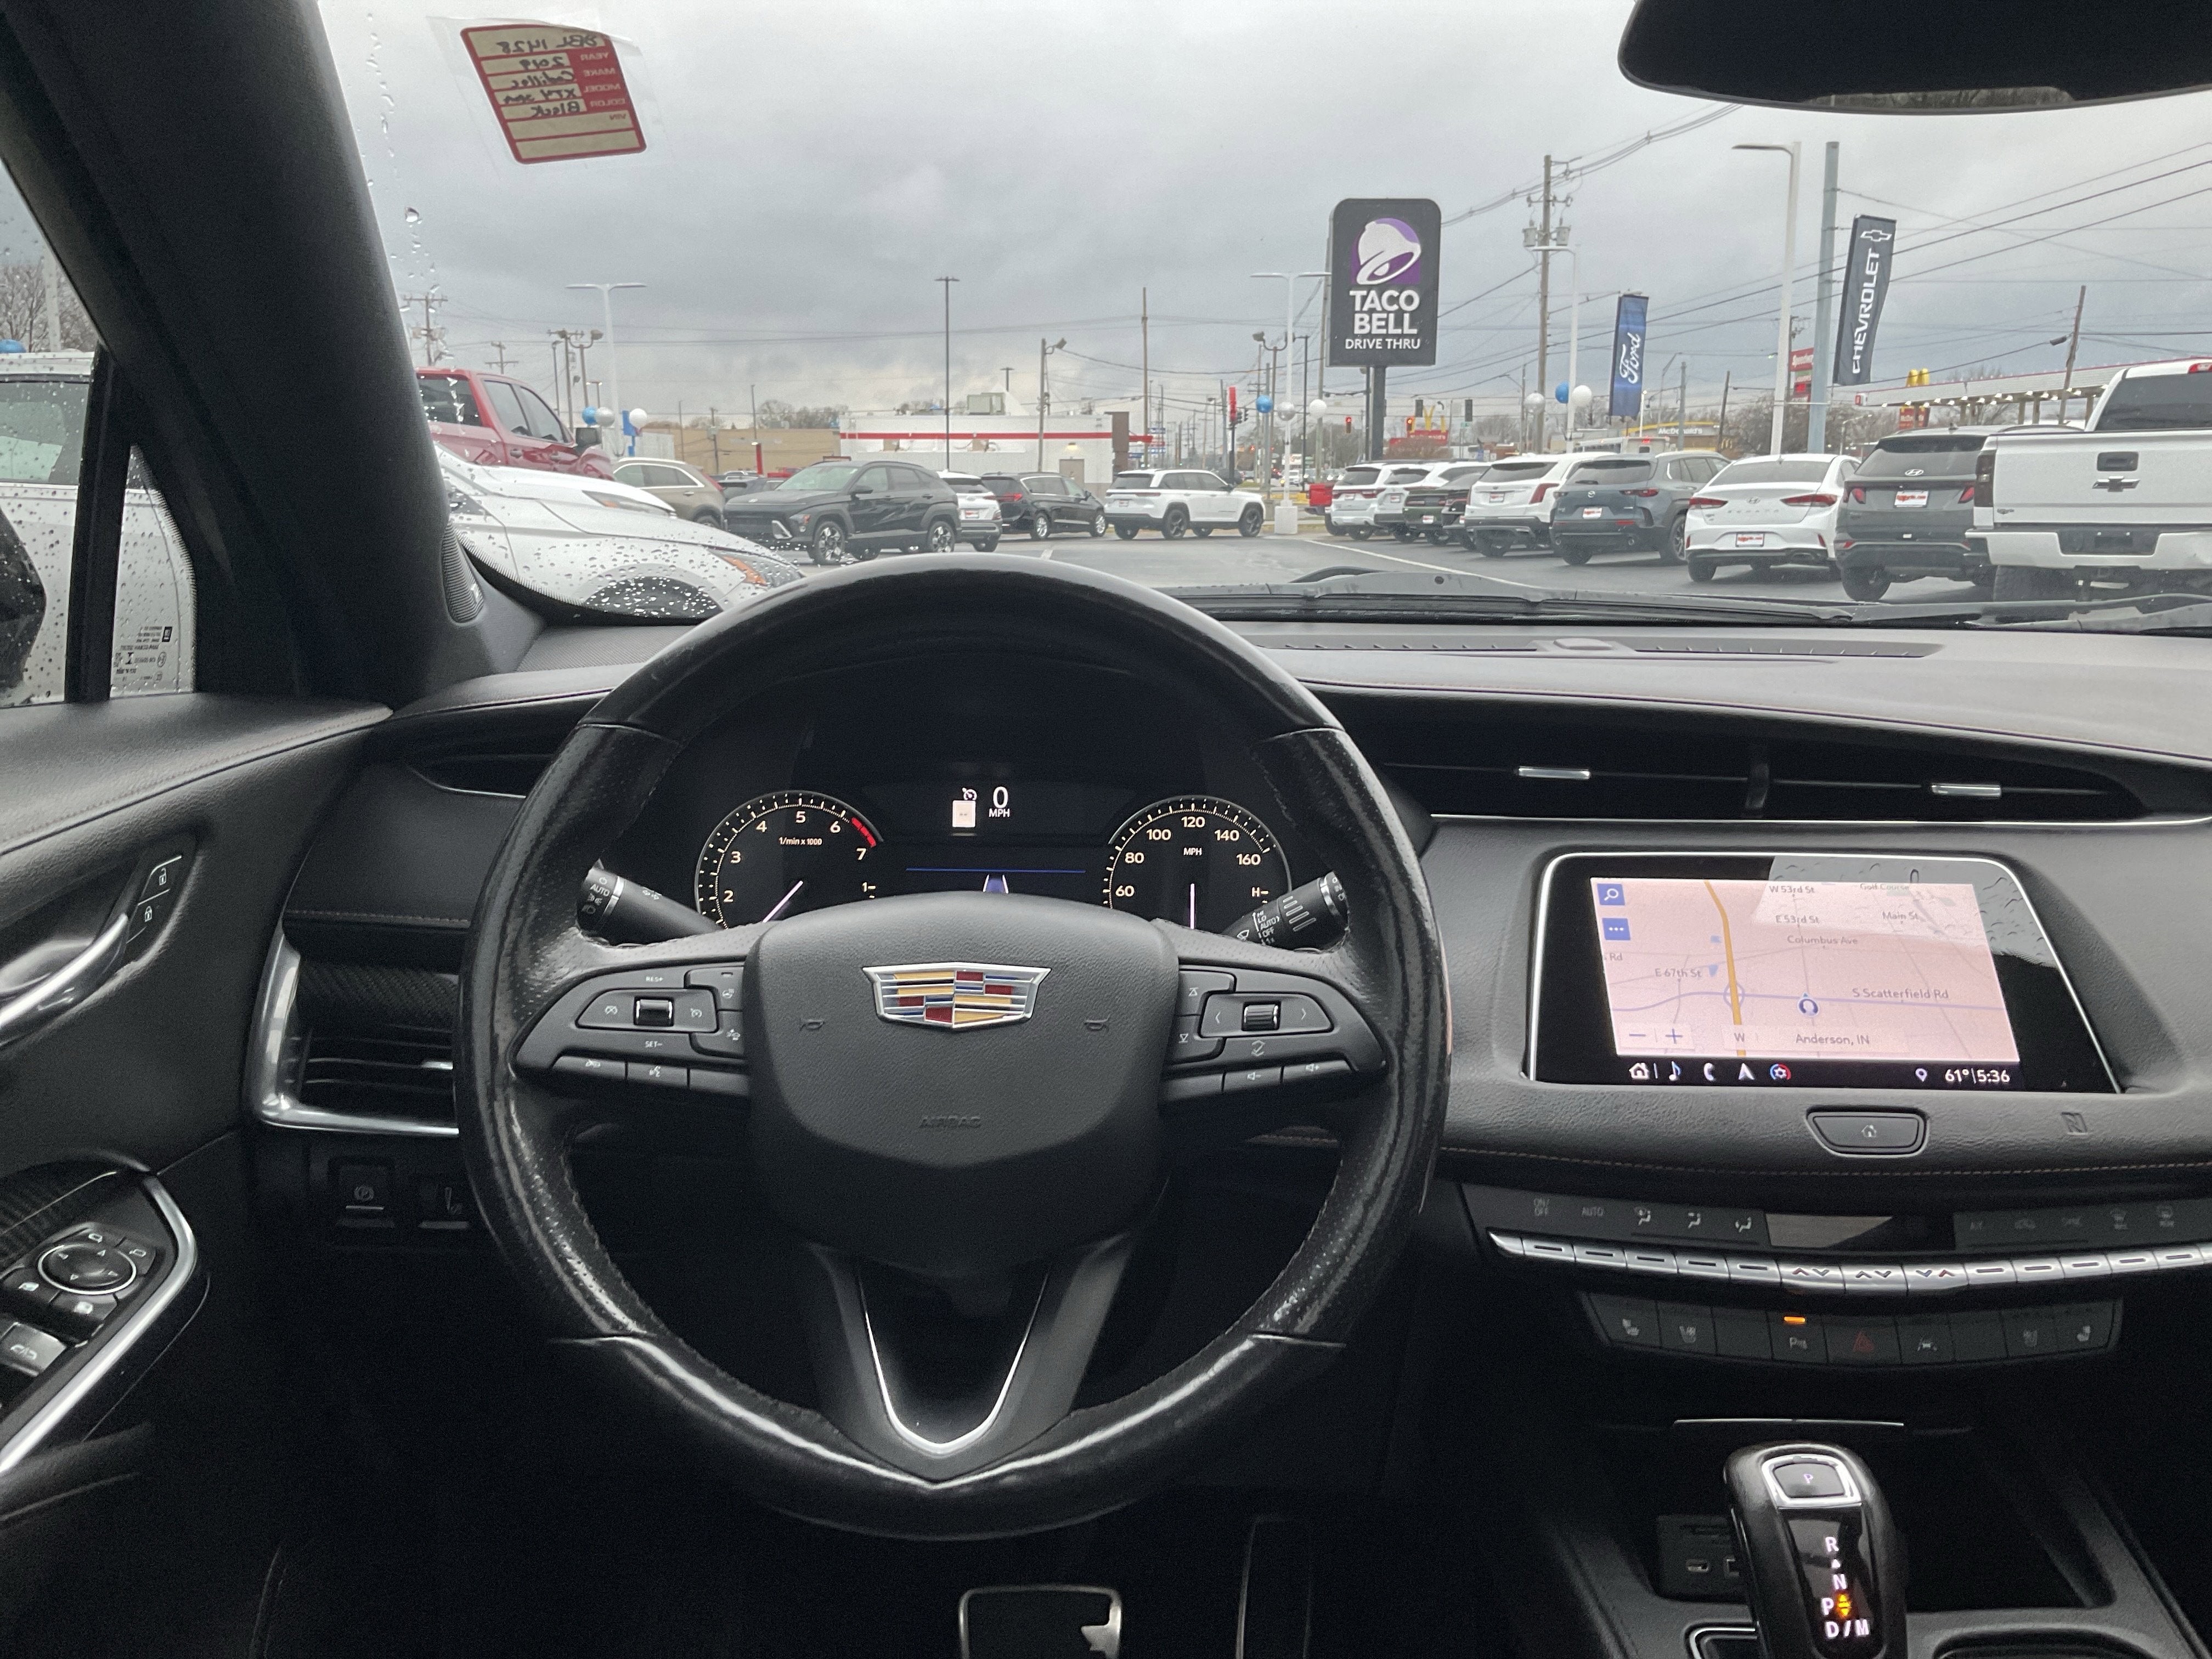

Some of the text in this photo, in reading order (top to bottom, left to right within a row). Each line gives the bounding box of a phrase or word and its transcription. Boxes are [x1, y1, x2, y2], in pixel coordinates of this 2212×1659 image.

[1349, 290, 1420, 311] TACO
[1852, 247, 1880, 374] CHEVROLET
[1353, 313, 1418, 335] BELL
[1345, 338, 1420, 349] DRIVE THRU
[1619, 332, 1641, 384] Ford
[992, 786, 1009, 809] 0
[795, 811, 806, 823] 5
[989, 808, 1010, 817] MPH
[756, 821, 767, 833] 4
[830, 821, 841, 833] 6
[1181, 816, 1206, 828] 120
[1146, 829, 1172, 841] 100
[1214, 830, 1240, 842] 140
[807, 838, 822, 846] 1000
[731, 851, 741, 864] 3
[856, 848, 867, 861] 7
[1183, 847, 1203, 856] MPH
[1125, 852, 1144, 864] 80
[1236, 854, 1261, 866] 160
[590, 884, 610, 897] AUTO
[723, 890, 733, 902] 2
[1115, 885, 1135, 898] 60
[1252, 887, 1260, 897] H
[1258, 915, 1267, 923] LO
[1775, 915, 1820, 924] E 53rd St
[1882, 911, 1919, 920] Main St
[1260, 917, 1277, 931] AUTO
[1262, 927, 1274, 938] OFF
[1787, 935, 1838, 944] Columbus
[1609, 952, 1623, 961] Rd
[1655, 968, 1702, 978] E 67th St
[1852, 988, 1949, 999] S Scatterfield Rd
[1734, 1032, 1870, 1046] W Anderson, IN
[1804, 1473, 1814, 1483] P
[1825, 1536, 1839, 1553] R
[1832, 1573, 1848, 1590] N
[1820, 1597, 1835, 1616] P
